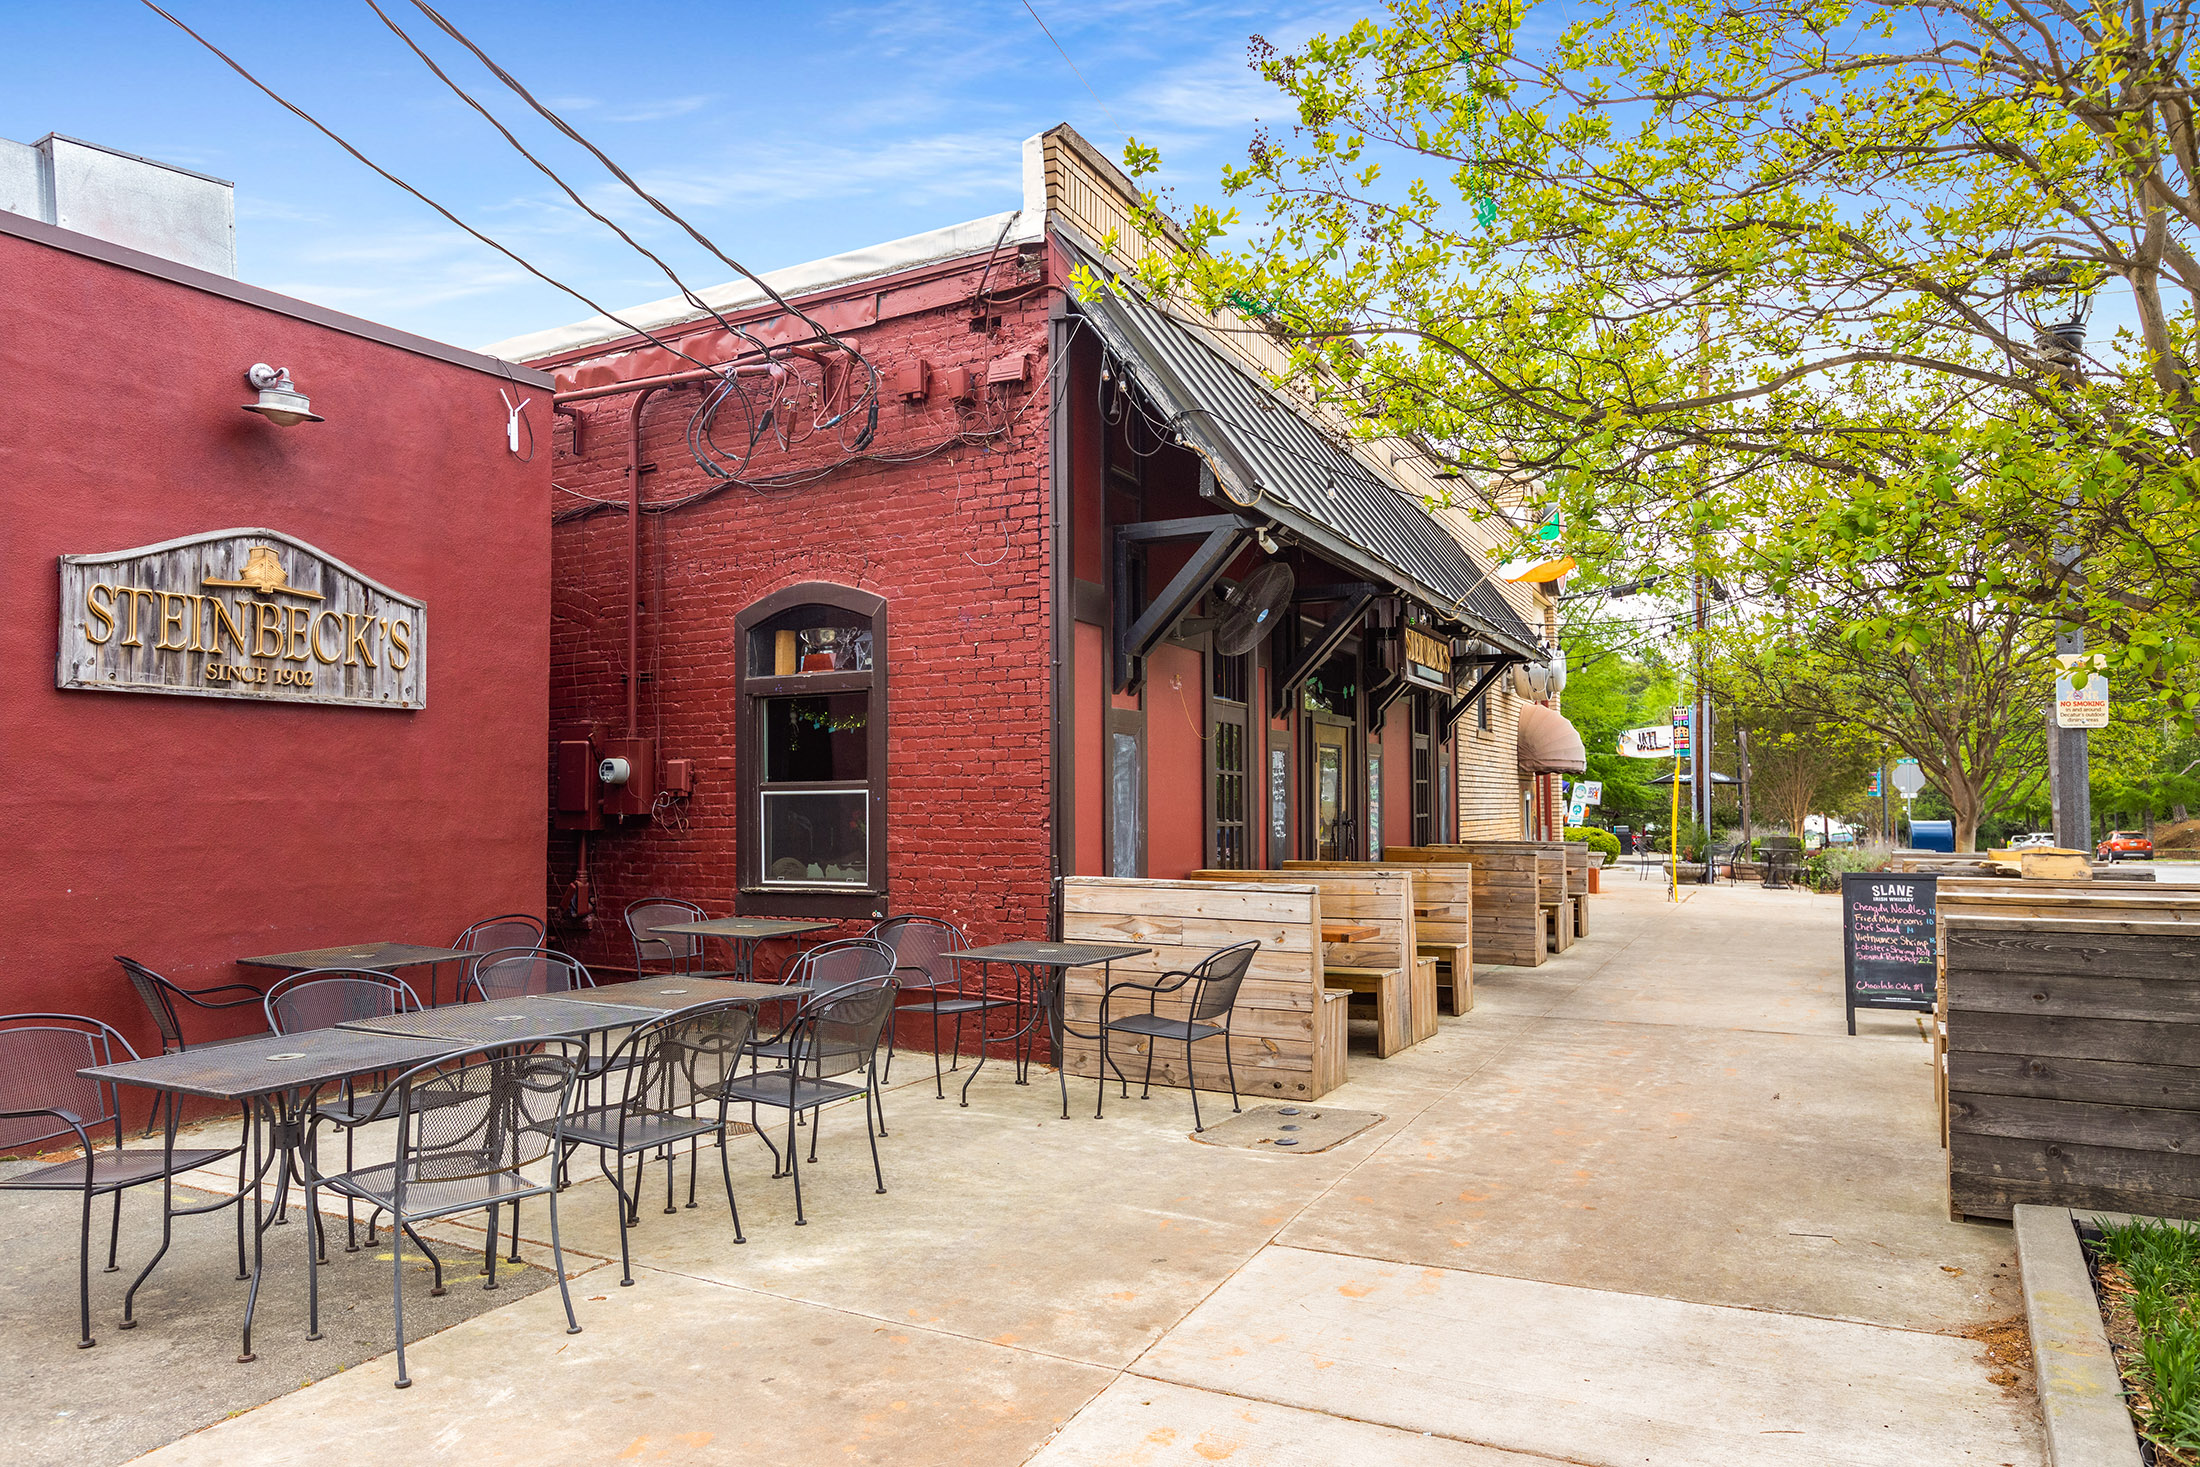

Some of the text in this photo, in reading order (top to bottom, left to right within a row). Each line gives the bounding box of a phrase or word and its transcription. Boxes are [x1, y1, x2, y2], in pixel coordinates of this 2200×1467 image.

[84, 583, 411, 670] STEINBECK'S
[205, 663, 314, 687] SINCE 1902
[1871, 884, 1915, 897] SLANE
[1853, 901, 1889, 916] Chengdu
[1891, 903, 1927, 916] Noodles
[1854, 913, 1877, 923] Fried
[1878, 914, 1923, 926] Mushrooms
[1855, 922, 1874, 931] Chef
[1875, 923, 1900, 934] Salad
[1899, 935, 1929, 949] Shrimp
[1855, 942, 1884, 952] Lobster
[1916, 947, 1931, 957] Roll
[1918, 956, 1933, 965] 22
